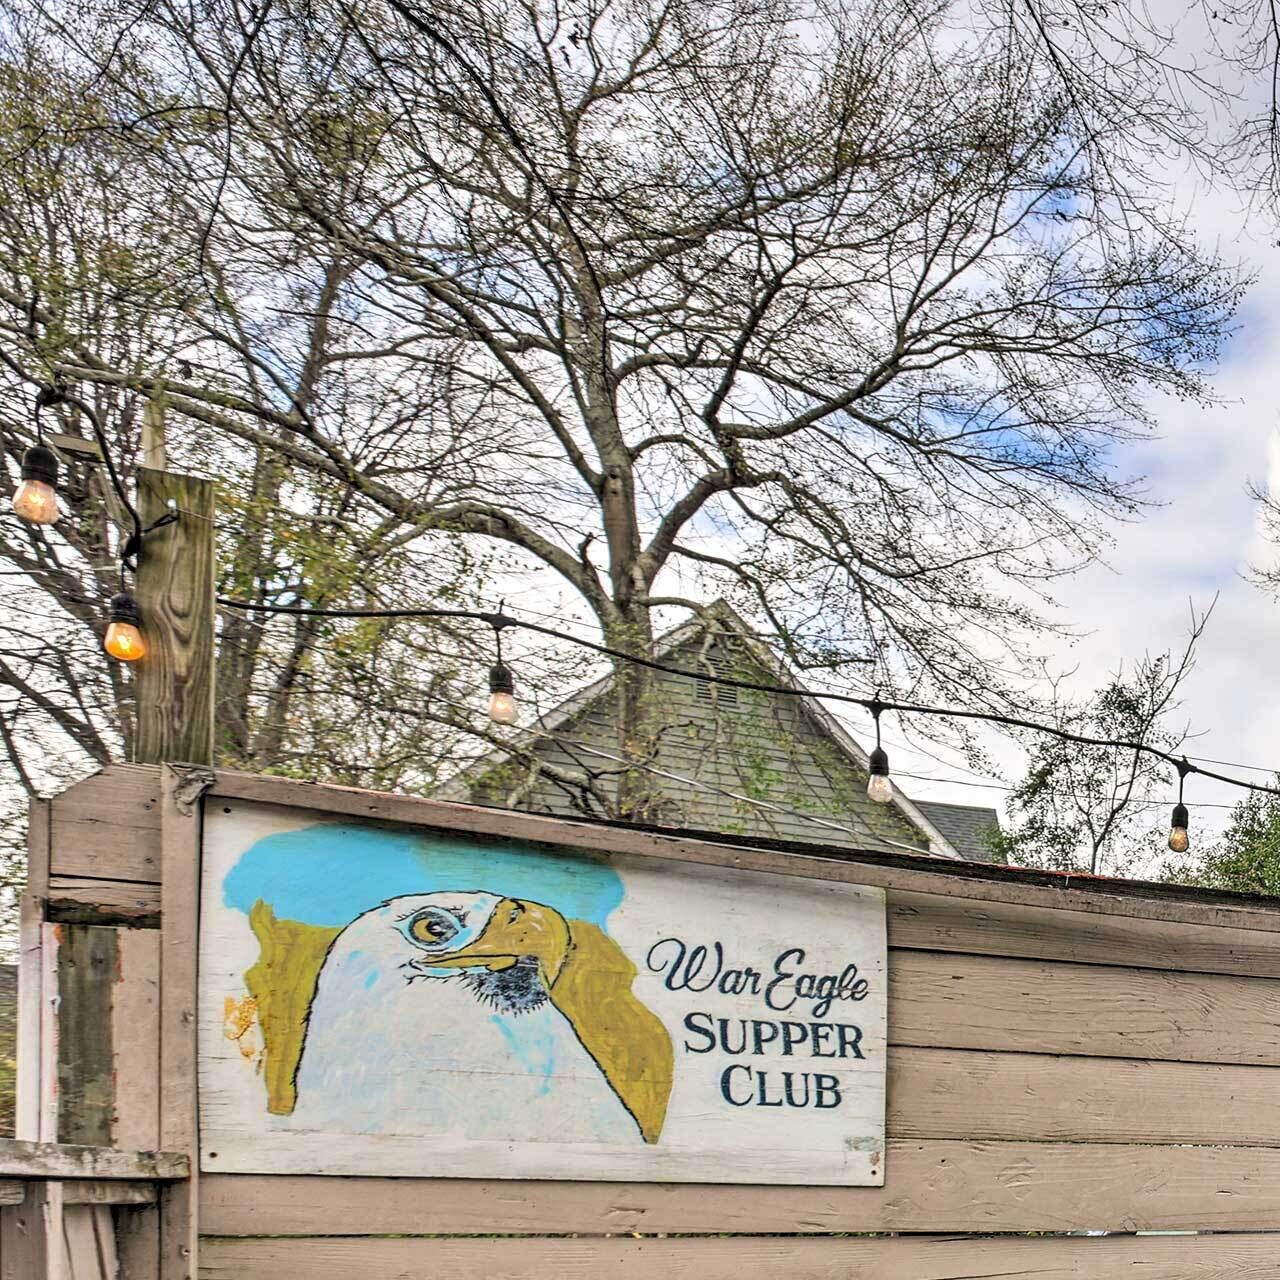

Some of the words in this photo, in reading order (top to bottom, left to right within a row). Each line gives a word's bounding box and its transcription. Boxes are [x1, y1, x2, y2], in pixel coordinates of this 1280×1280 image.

[646, 937, 761, 995] War
[765, 948, 869, 1018] Eagle
[683, 1011, 866, 1059] SUPPER
[720, 1064, 842, 1109] CLUB
